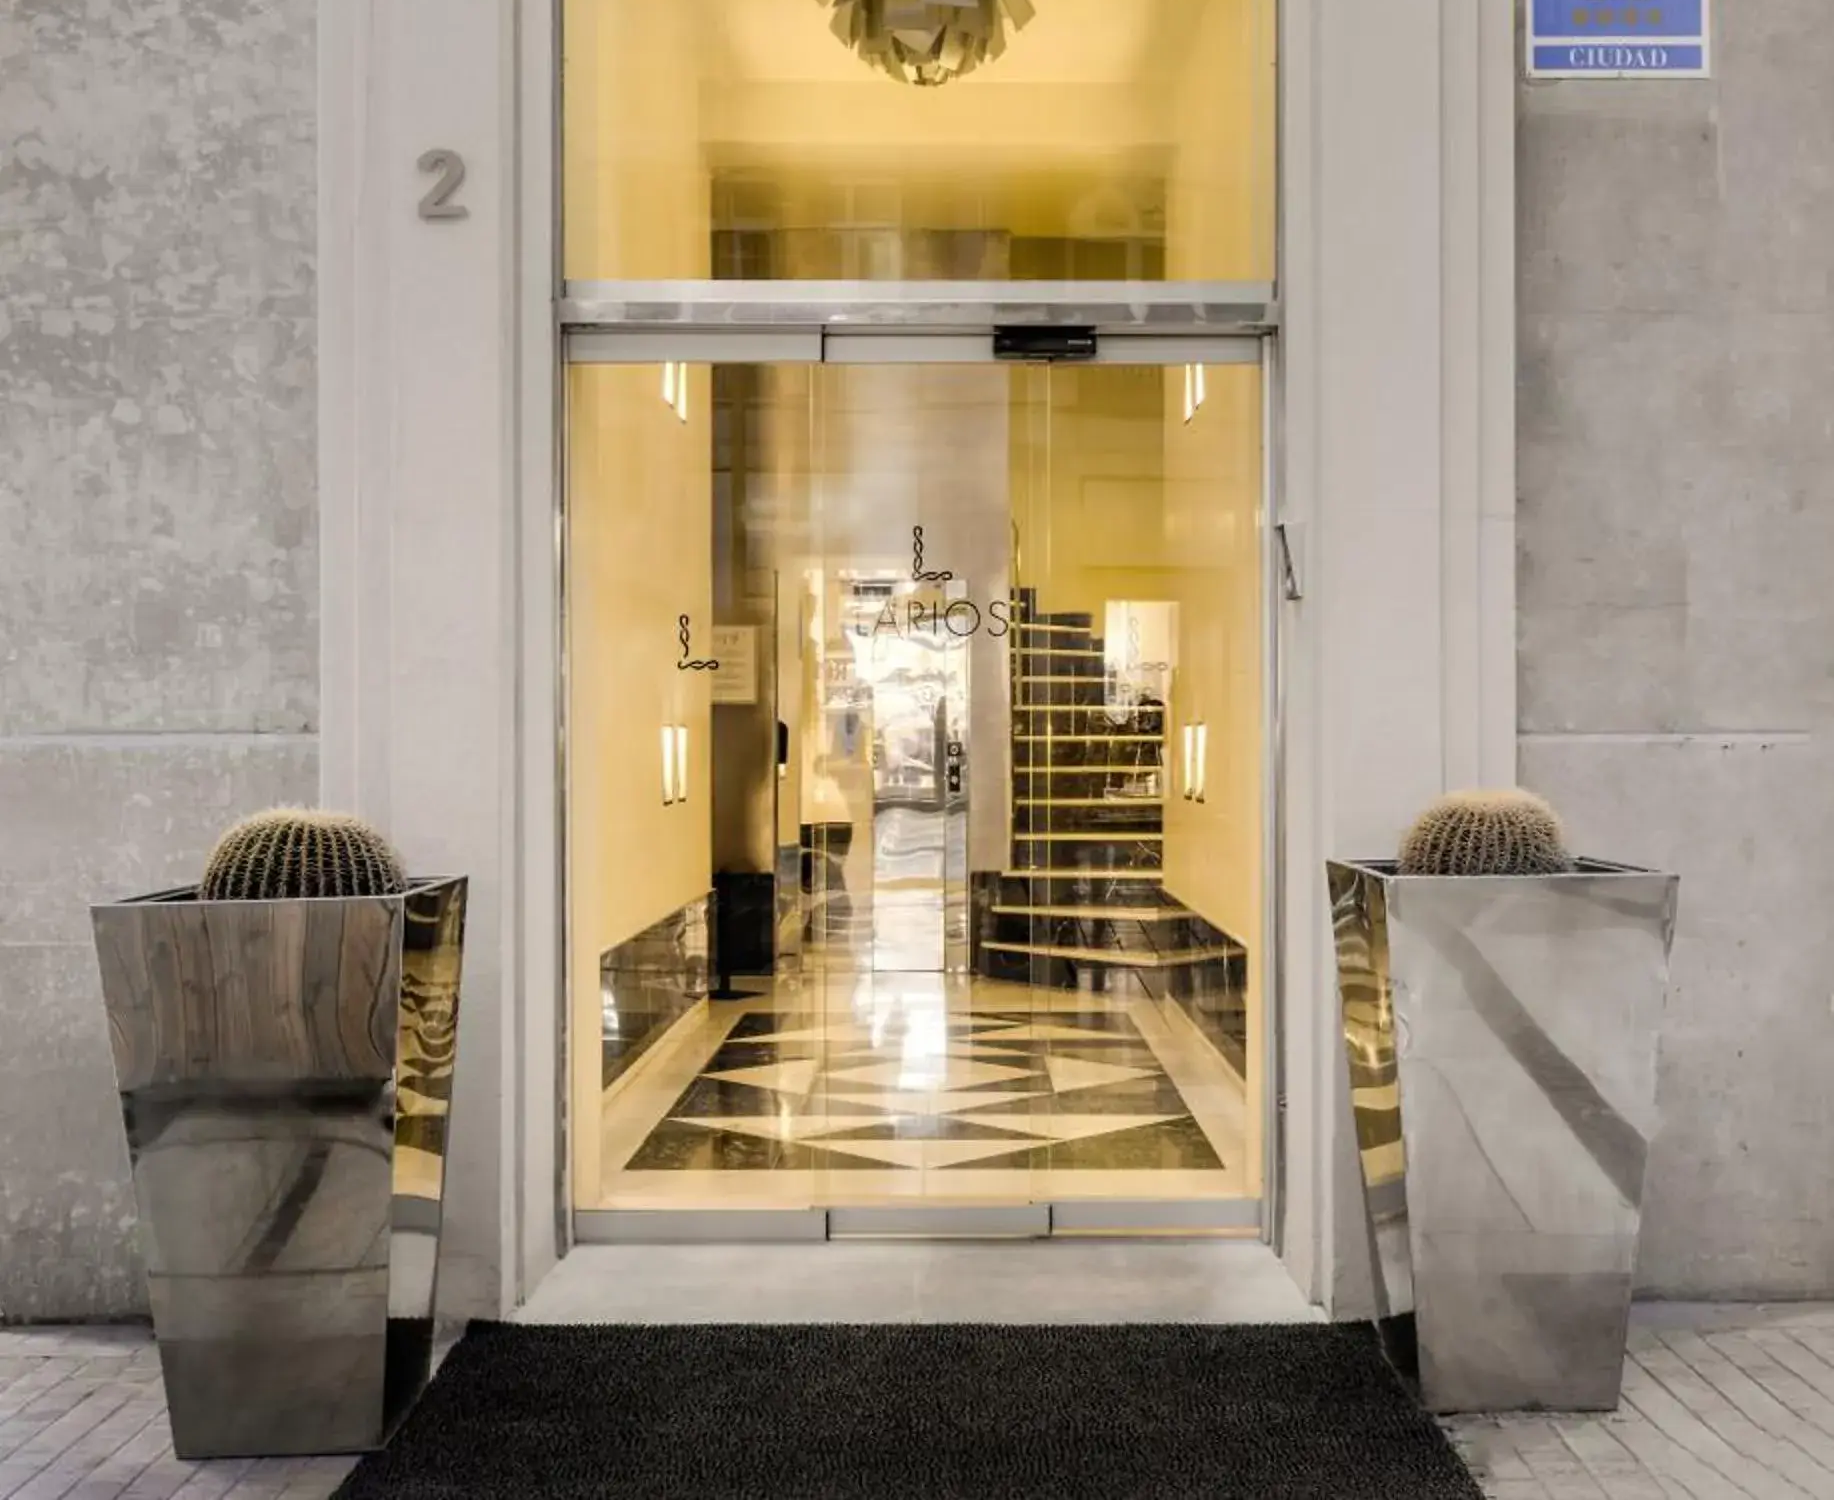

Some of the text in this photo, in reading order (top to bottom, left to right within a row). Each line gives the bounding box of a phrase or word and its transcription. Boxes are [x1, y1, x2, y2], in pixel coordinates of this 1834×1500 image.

[1568, 47, 1668, 68] CIUDAD
[416, 148, 471, 224] 2
[855, 599, 1009, 638] LARIOS
